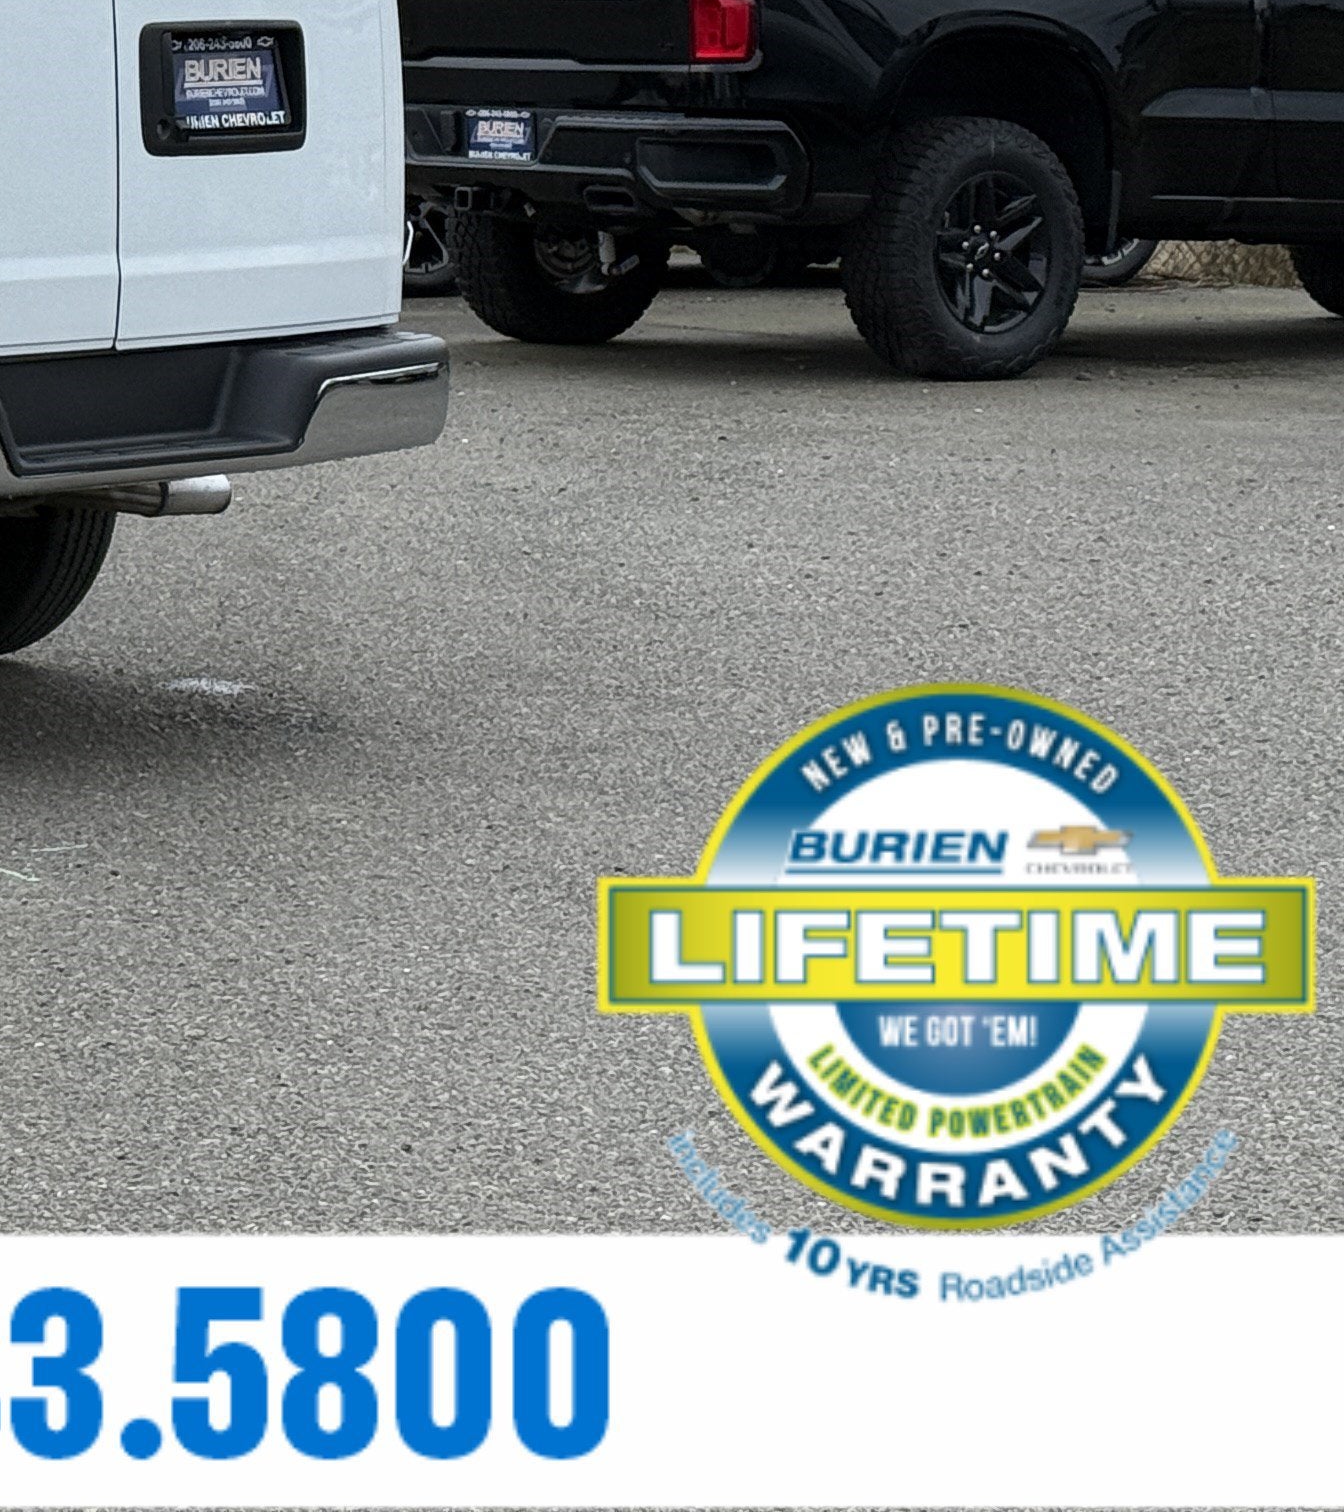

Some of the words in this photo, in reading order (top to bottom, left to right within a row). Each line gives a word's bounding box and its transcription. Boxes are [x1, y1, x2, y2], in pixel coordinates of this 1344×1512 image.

[184, 57, 261, 82] BURIEN
[221, 111, 285, 128] CHEVROLET
[477, 120, 524, 136] BURIEN
